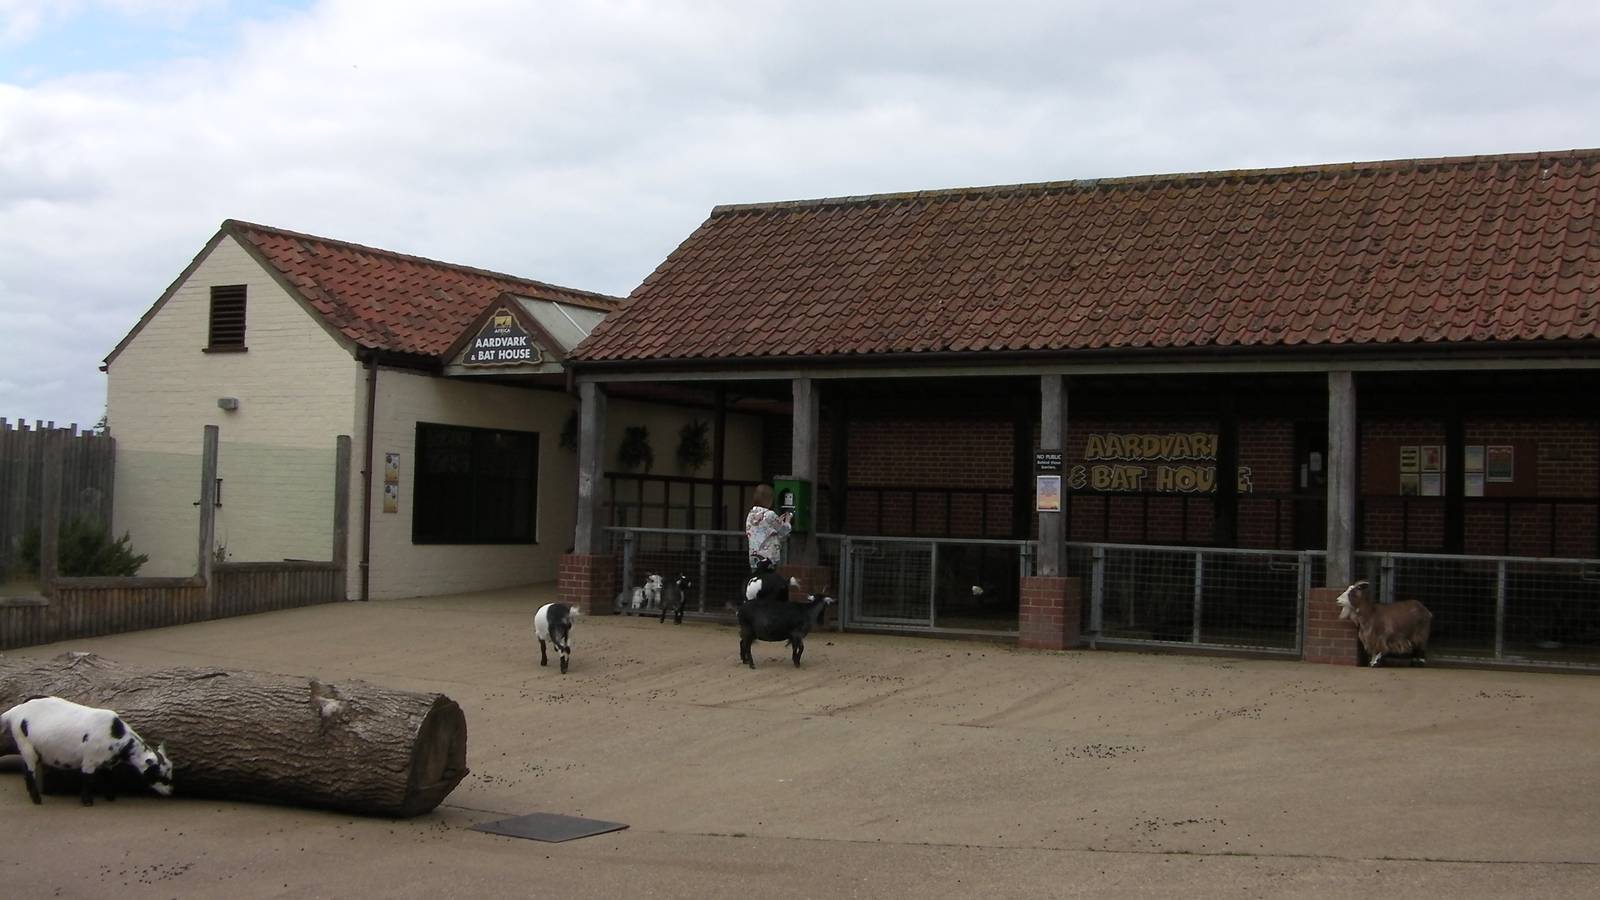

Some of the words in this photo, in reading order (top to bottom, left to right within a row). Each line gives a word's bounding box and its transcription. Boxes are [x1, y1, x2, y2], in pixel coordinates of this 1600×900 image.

[475, 336, 526, 348] AARDVARK
[478, 350, 495, 360] BAT
[499, 349, 530, 360] HOUSE
[1092, 464, 1147, 491] BAT
[1156, 466, 1253, 492] HOUE
